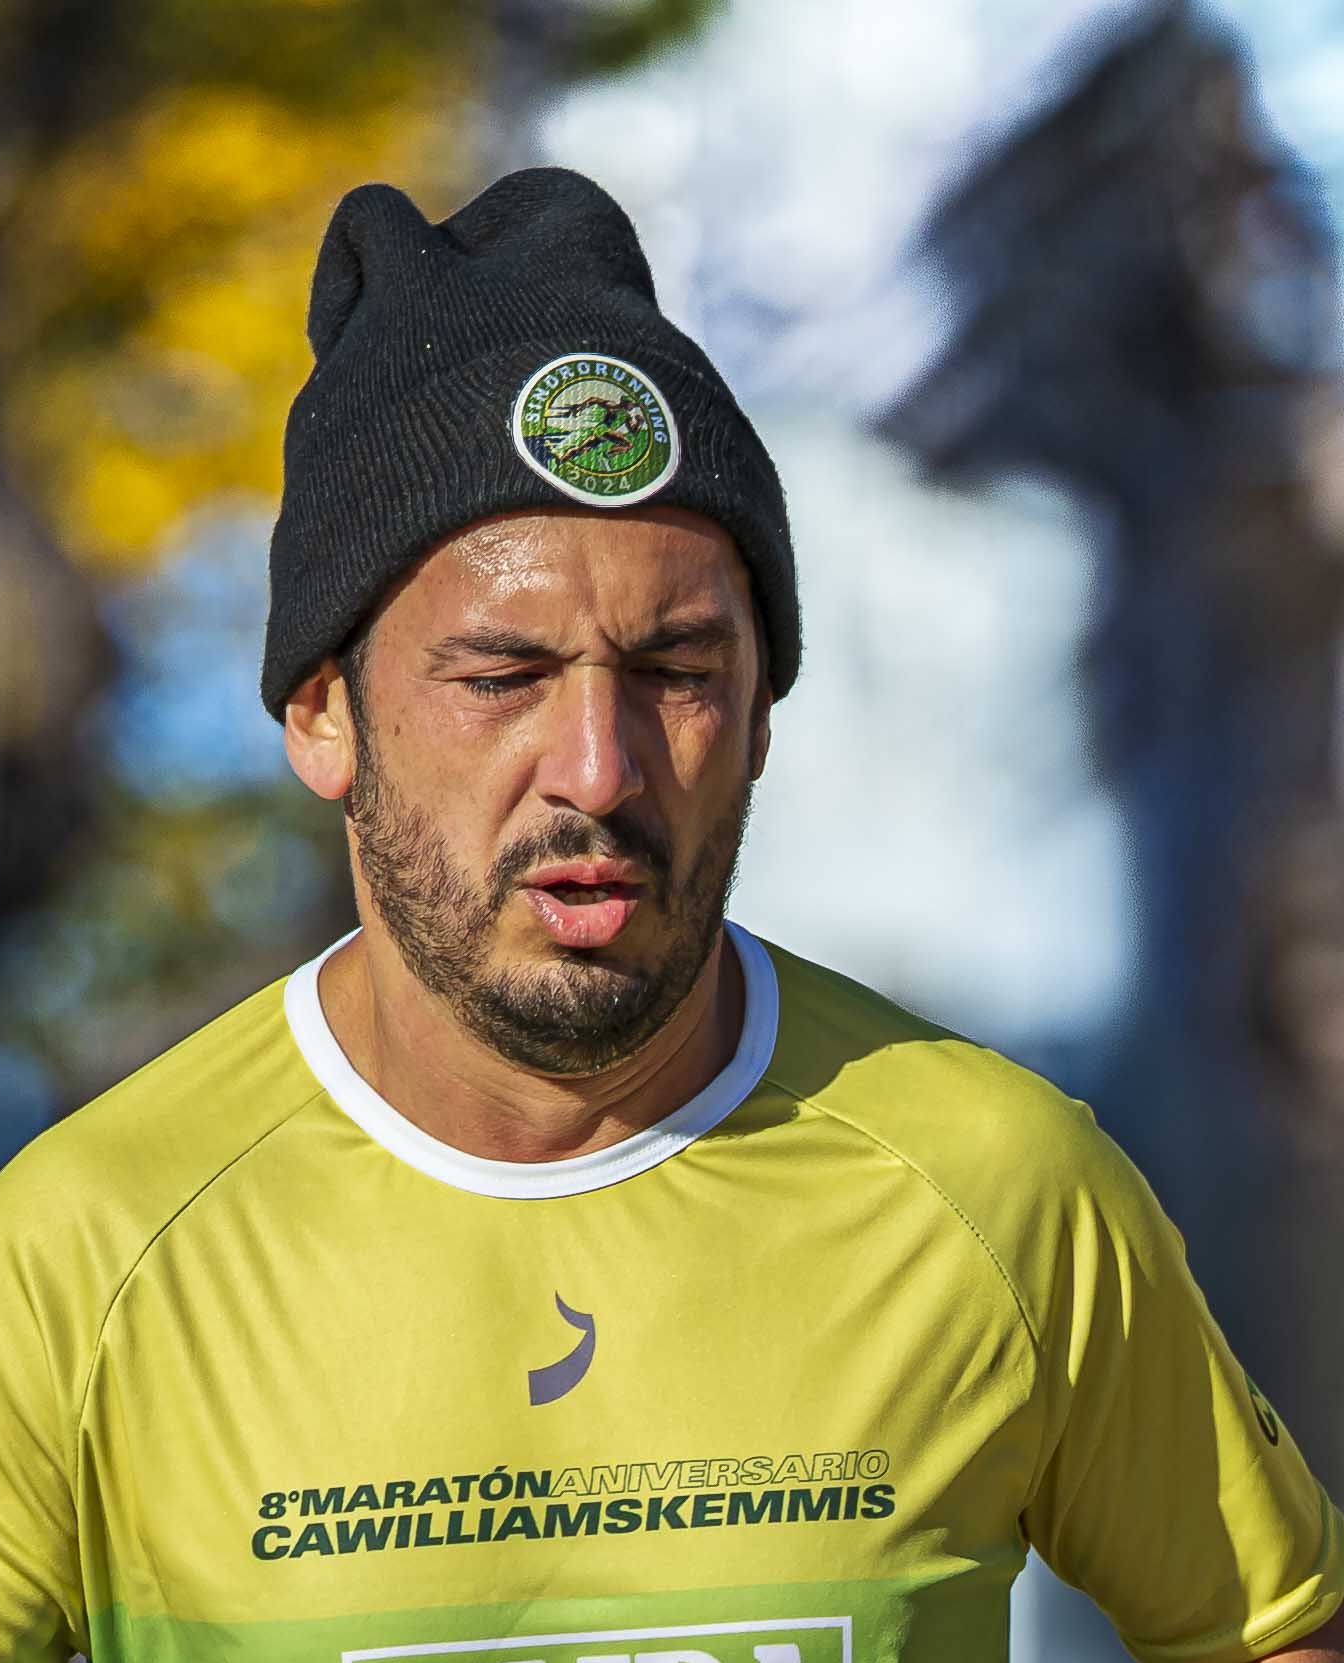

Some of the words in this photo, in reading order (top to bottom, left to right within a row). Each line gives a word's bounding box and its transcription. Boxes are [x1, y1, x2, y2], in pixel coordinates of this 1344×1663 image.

[526, 361, 668, 444] SINDRORUNNING
[567, 468, 632, 494] 2024
[251, 1484, 896, 1560] CAWILLIAMSKEMMIS
